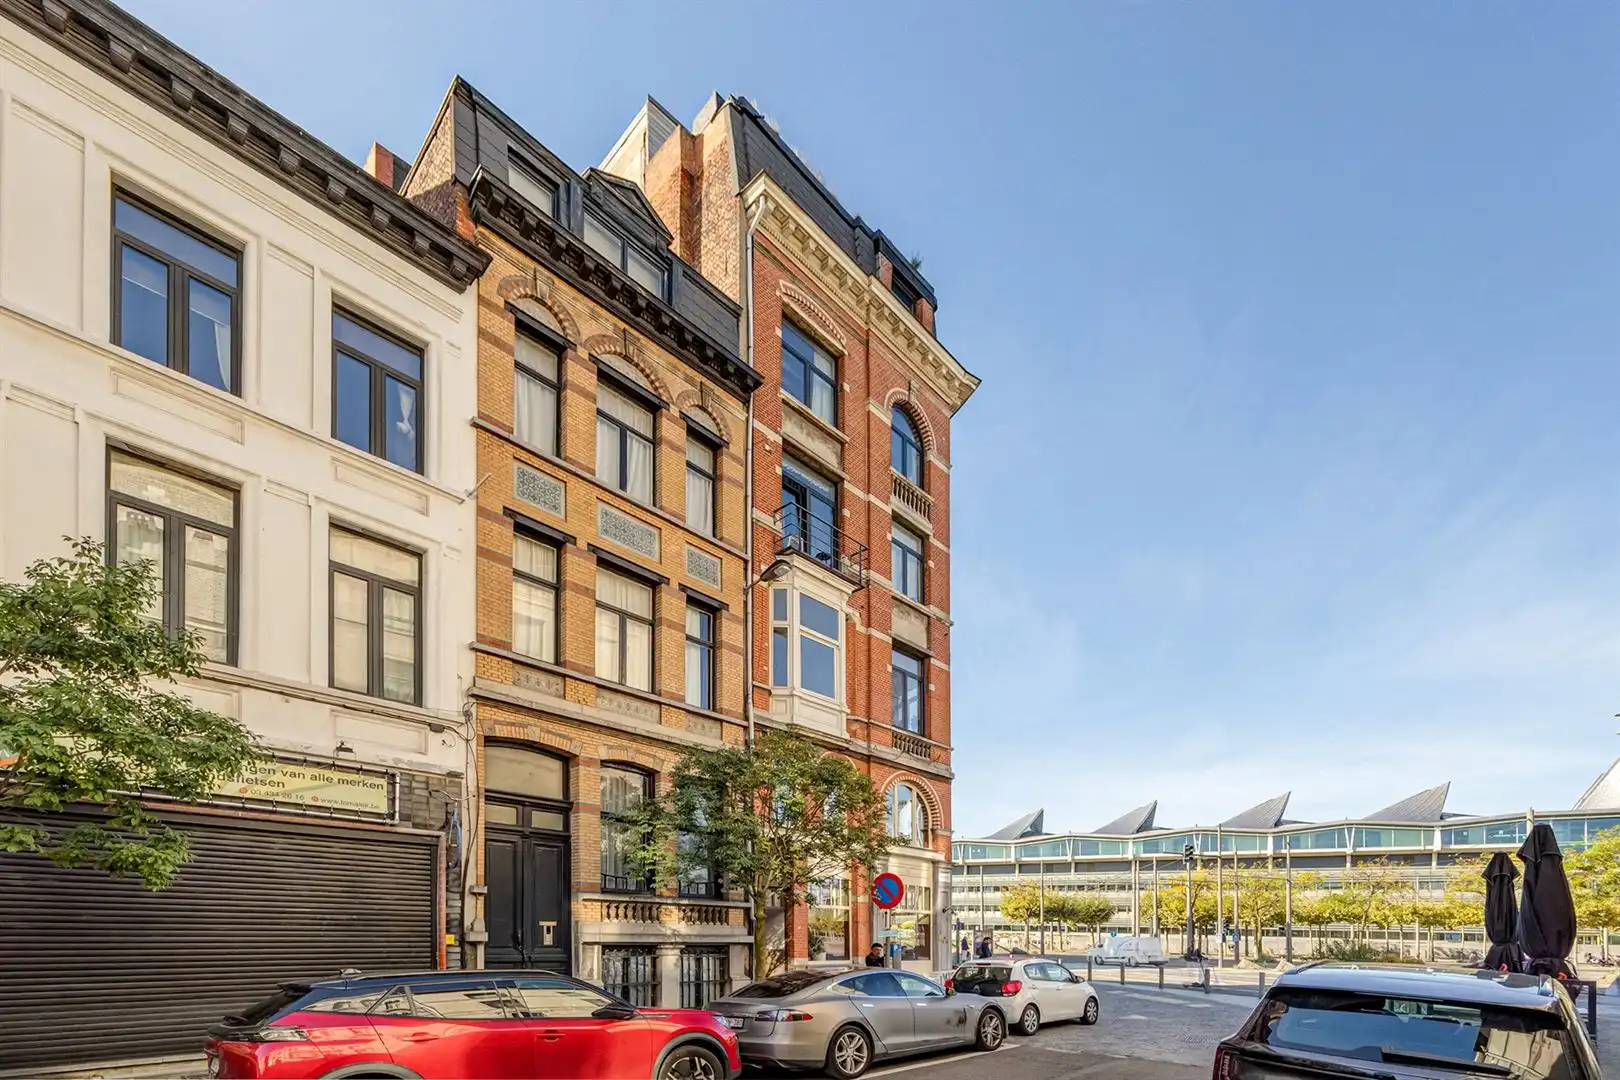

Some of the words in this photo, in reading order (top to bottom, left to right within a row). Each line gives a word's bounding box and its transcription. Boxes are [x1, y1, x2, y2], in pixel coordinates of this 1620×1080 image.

[280, 769, 306, 780] van
[309, 773, 334, 784] alle
[337, 777, 384, 790] merken
